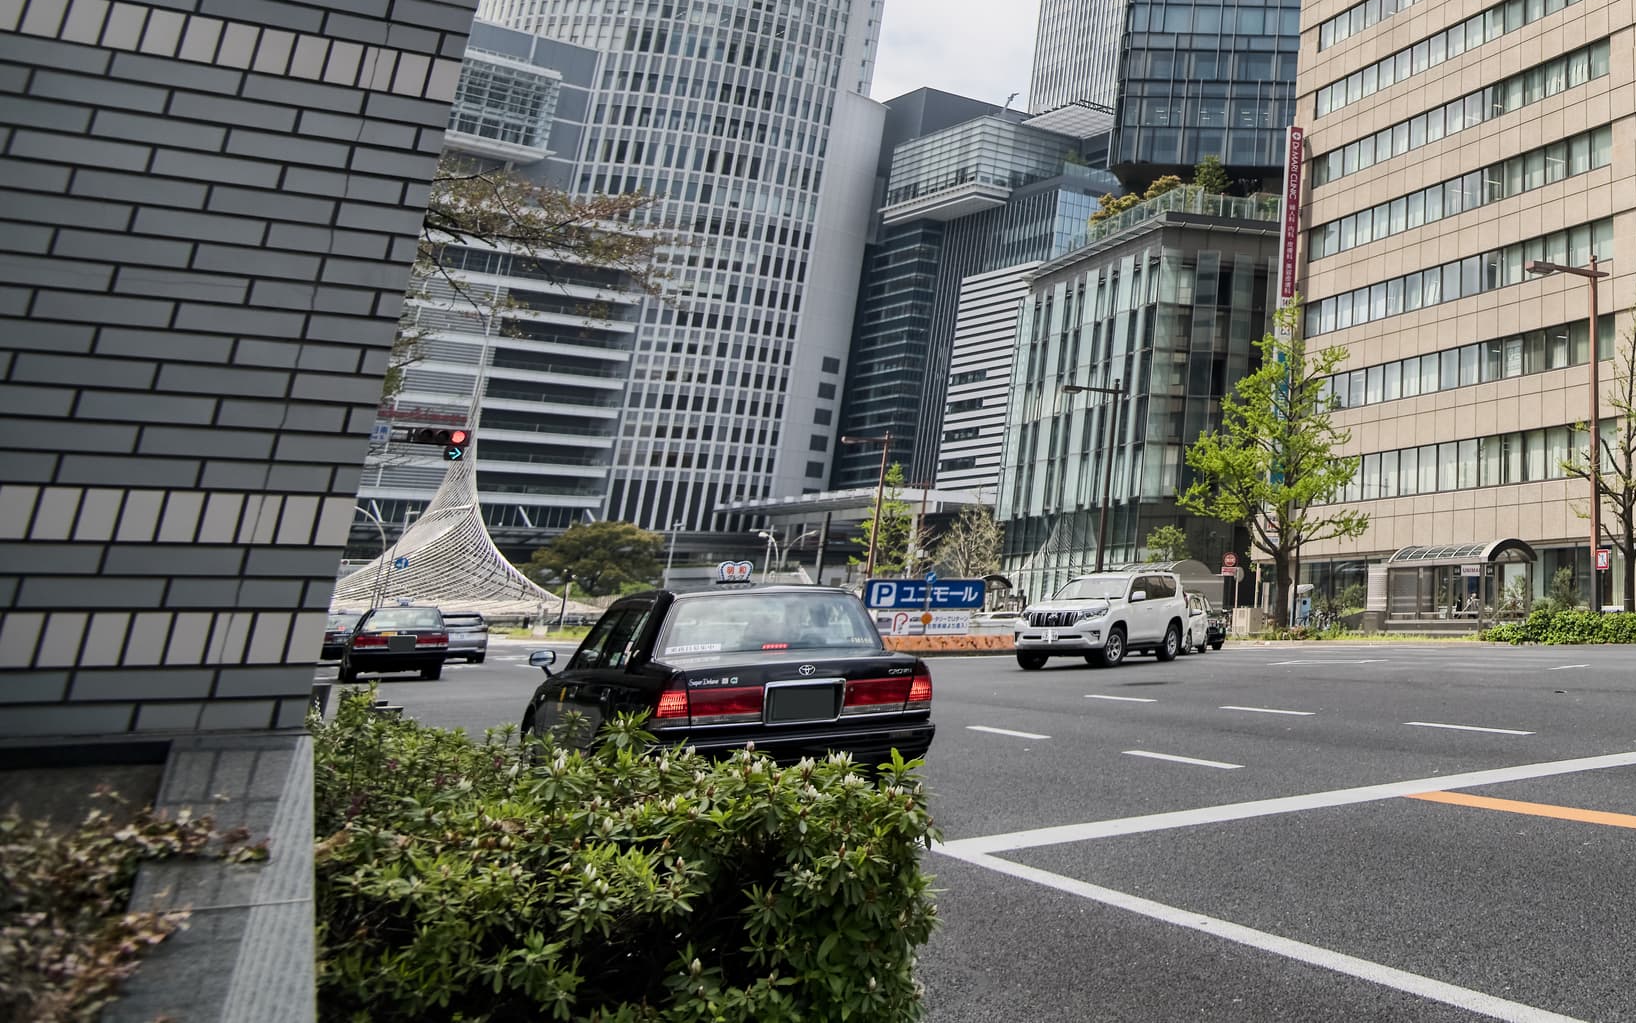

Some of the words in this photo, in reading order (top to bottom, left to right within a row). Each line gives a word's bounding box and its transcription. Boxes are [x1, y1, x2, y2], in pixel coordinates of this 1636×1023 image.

[1291, 141, 1300, 172] Dr.MARI
[1288, 174, 1298, 200] CLINIC
[874, 583, 894, 606] P
[900, 586, 979, 602] ユニモール
